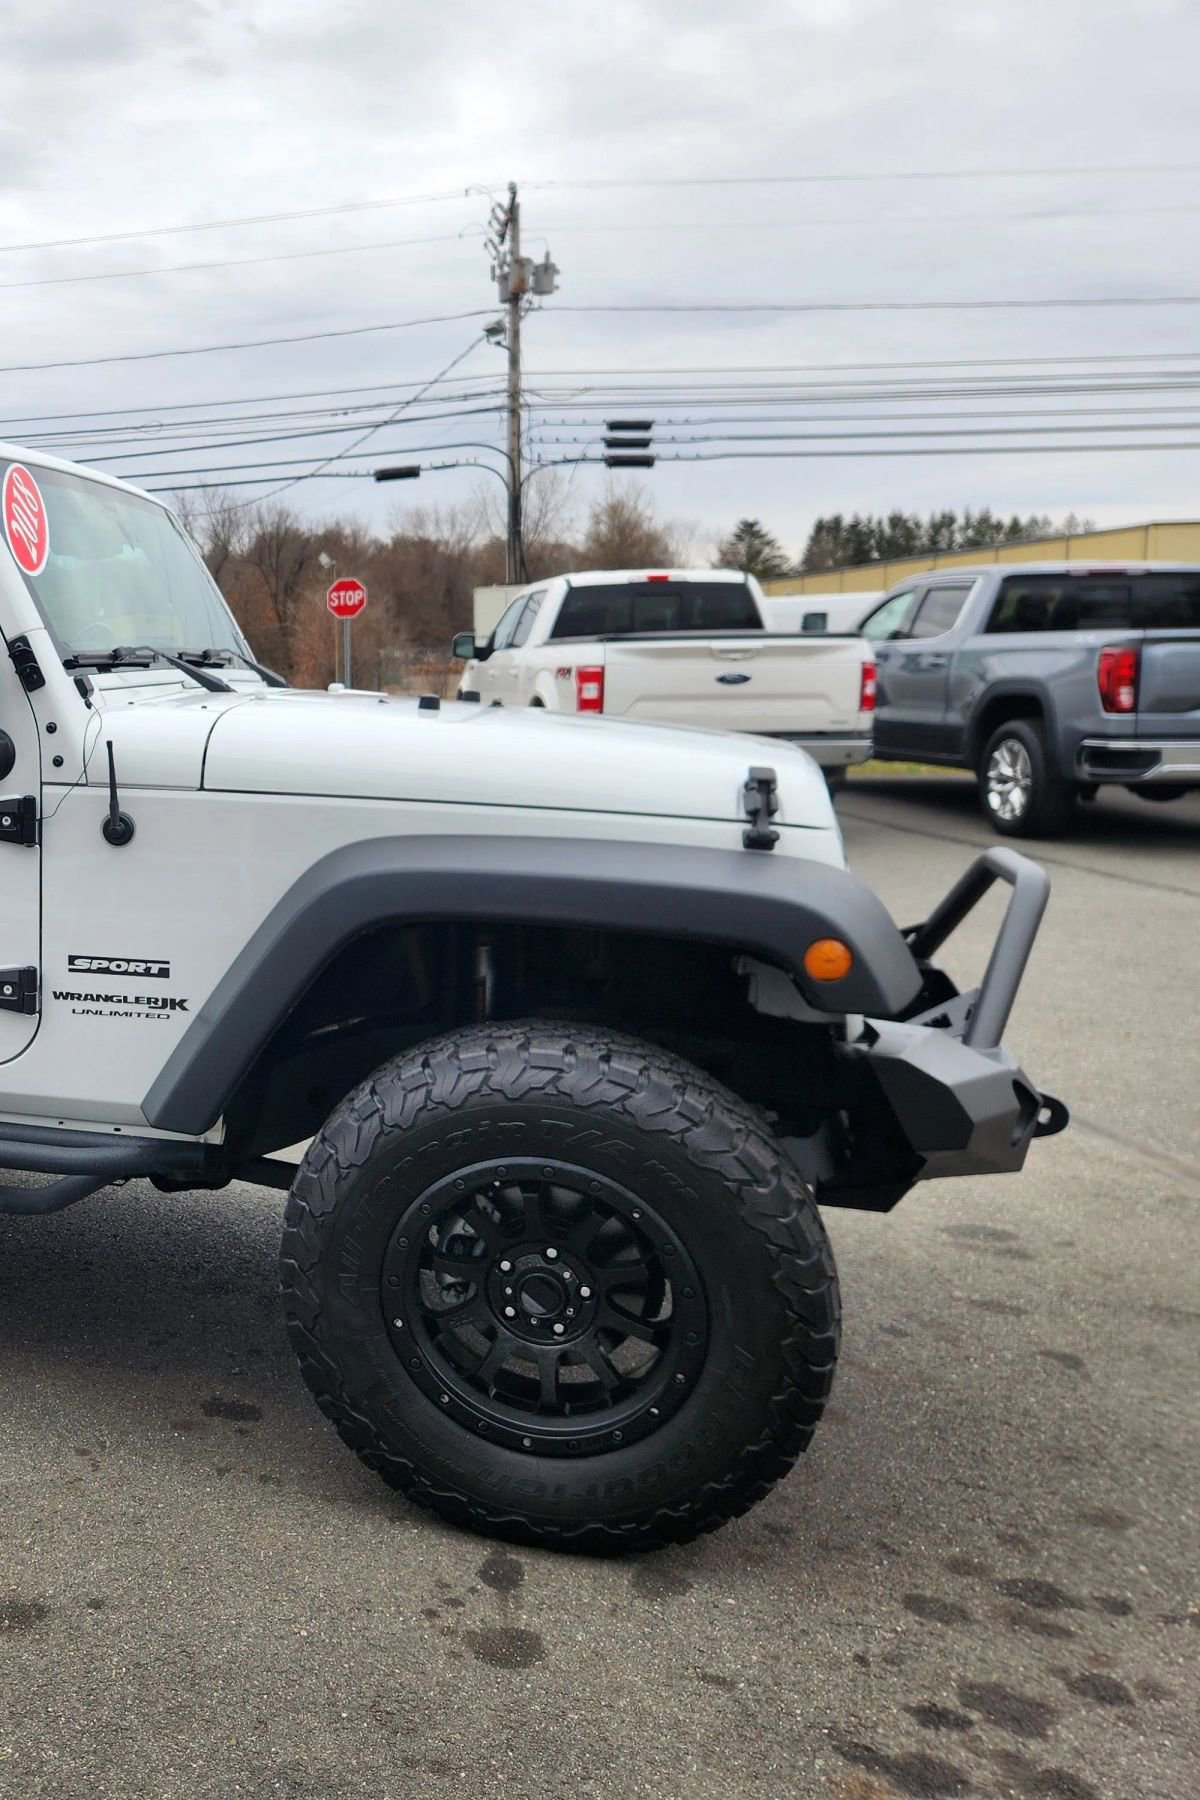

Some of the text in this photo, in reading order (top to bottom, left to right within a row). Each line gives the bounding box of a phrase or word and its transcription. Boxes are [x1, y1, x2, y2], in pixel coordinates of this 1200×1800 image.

[11, 471, 39, 565] 2018
[330, 589, 363, 607] STOP
[69, 957, 170, 975] SPORT
[71, 1008, 171, 1020] UNLIMITED
